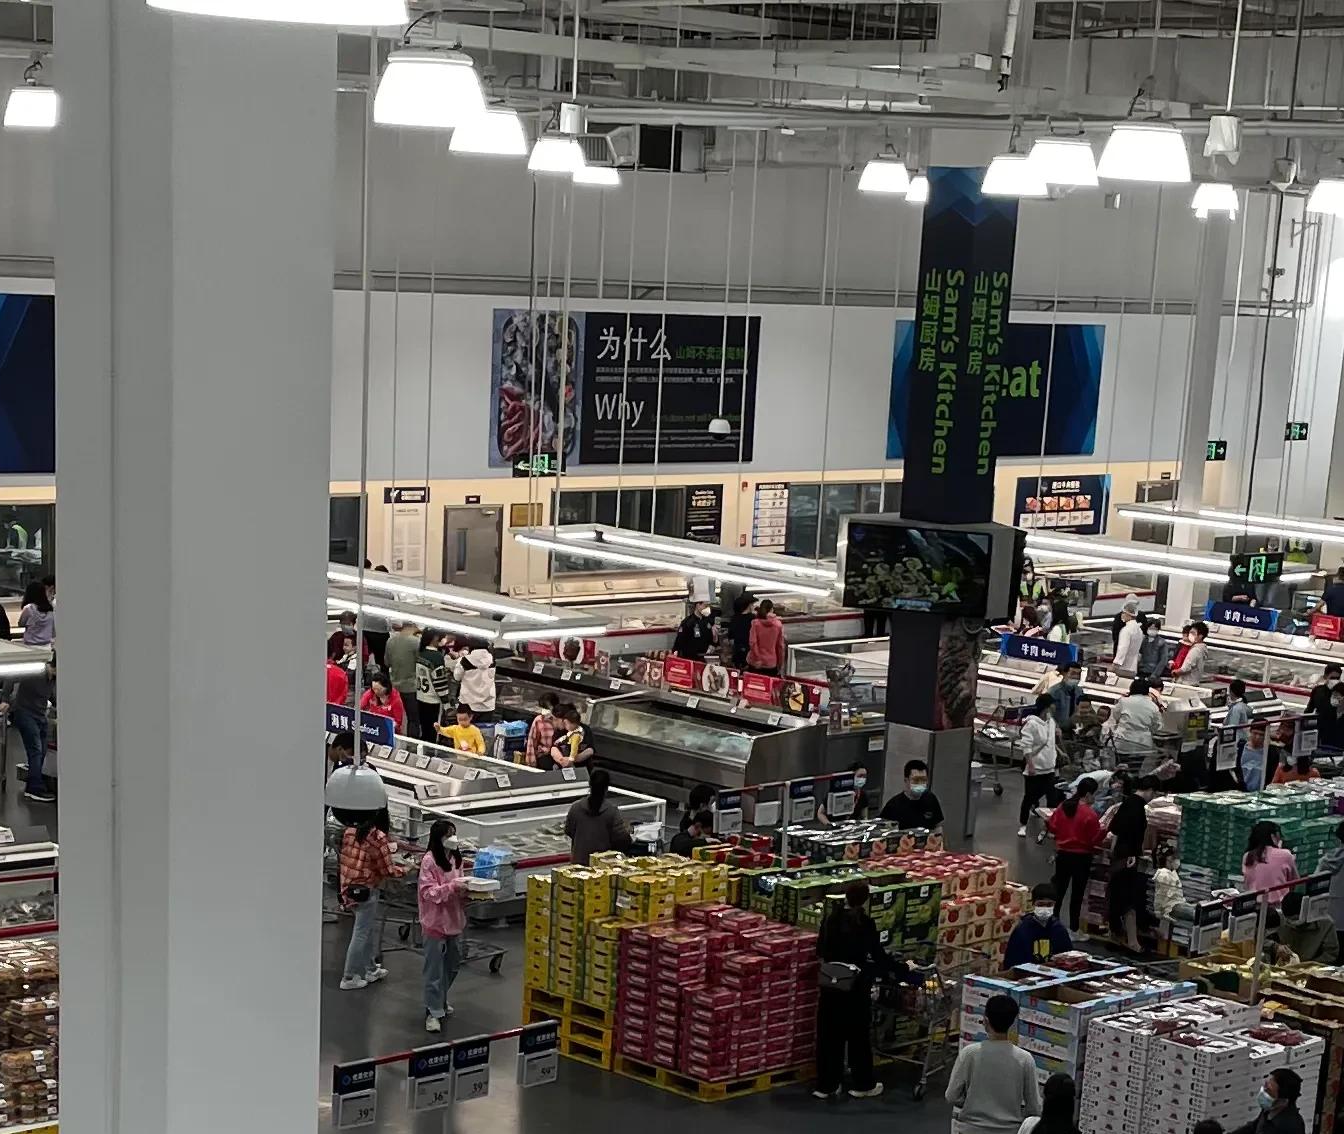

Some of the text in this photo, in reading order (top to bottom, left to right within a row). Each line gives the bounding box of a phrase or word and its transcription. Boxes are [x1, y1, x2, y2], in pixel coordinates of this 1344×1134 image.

[597, 326, 672, 361] 为什么
[918, 268, 943, 372] 山姆厨房
[931, 269, 965, 475] Sam's Kitchen
[966, 271, 990, 375] 山姆厨房
[594, 393, 645, 428] Why
[976, 271, 1009, 475] Sam's Kitchen
[1021, 643, 1039, 657] 牛肉
